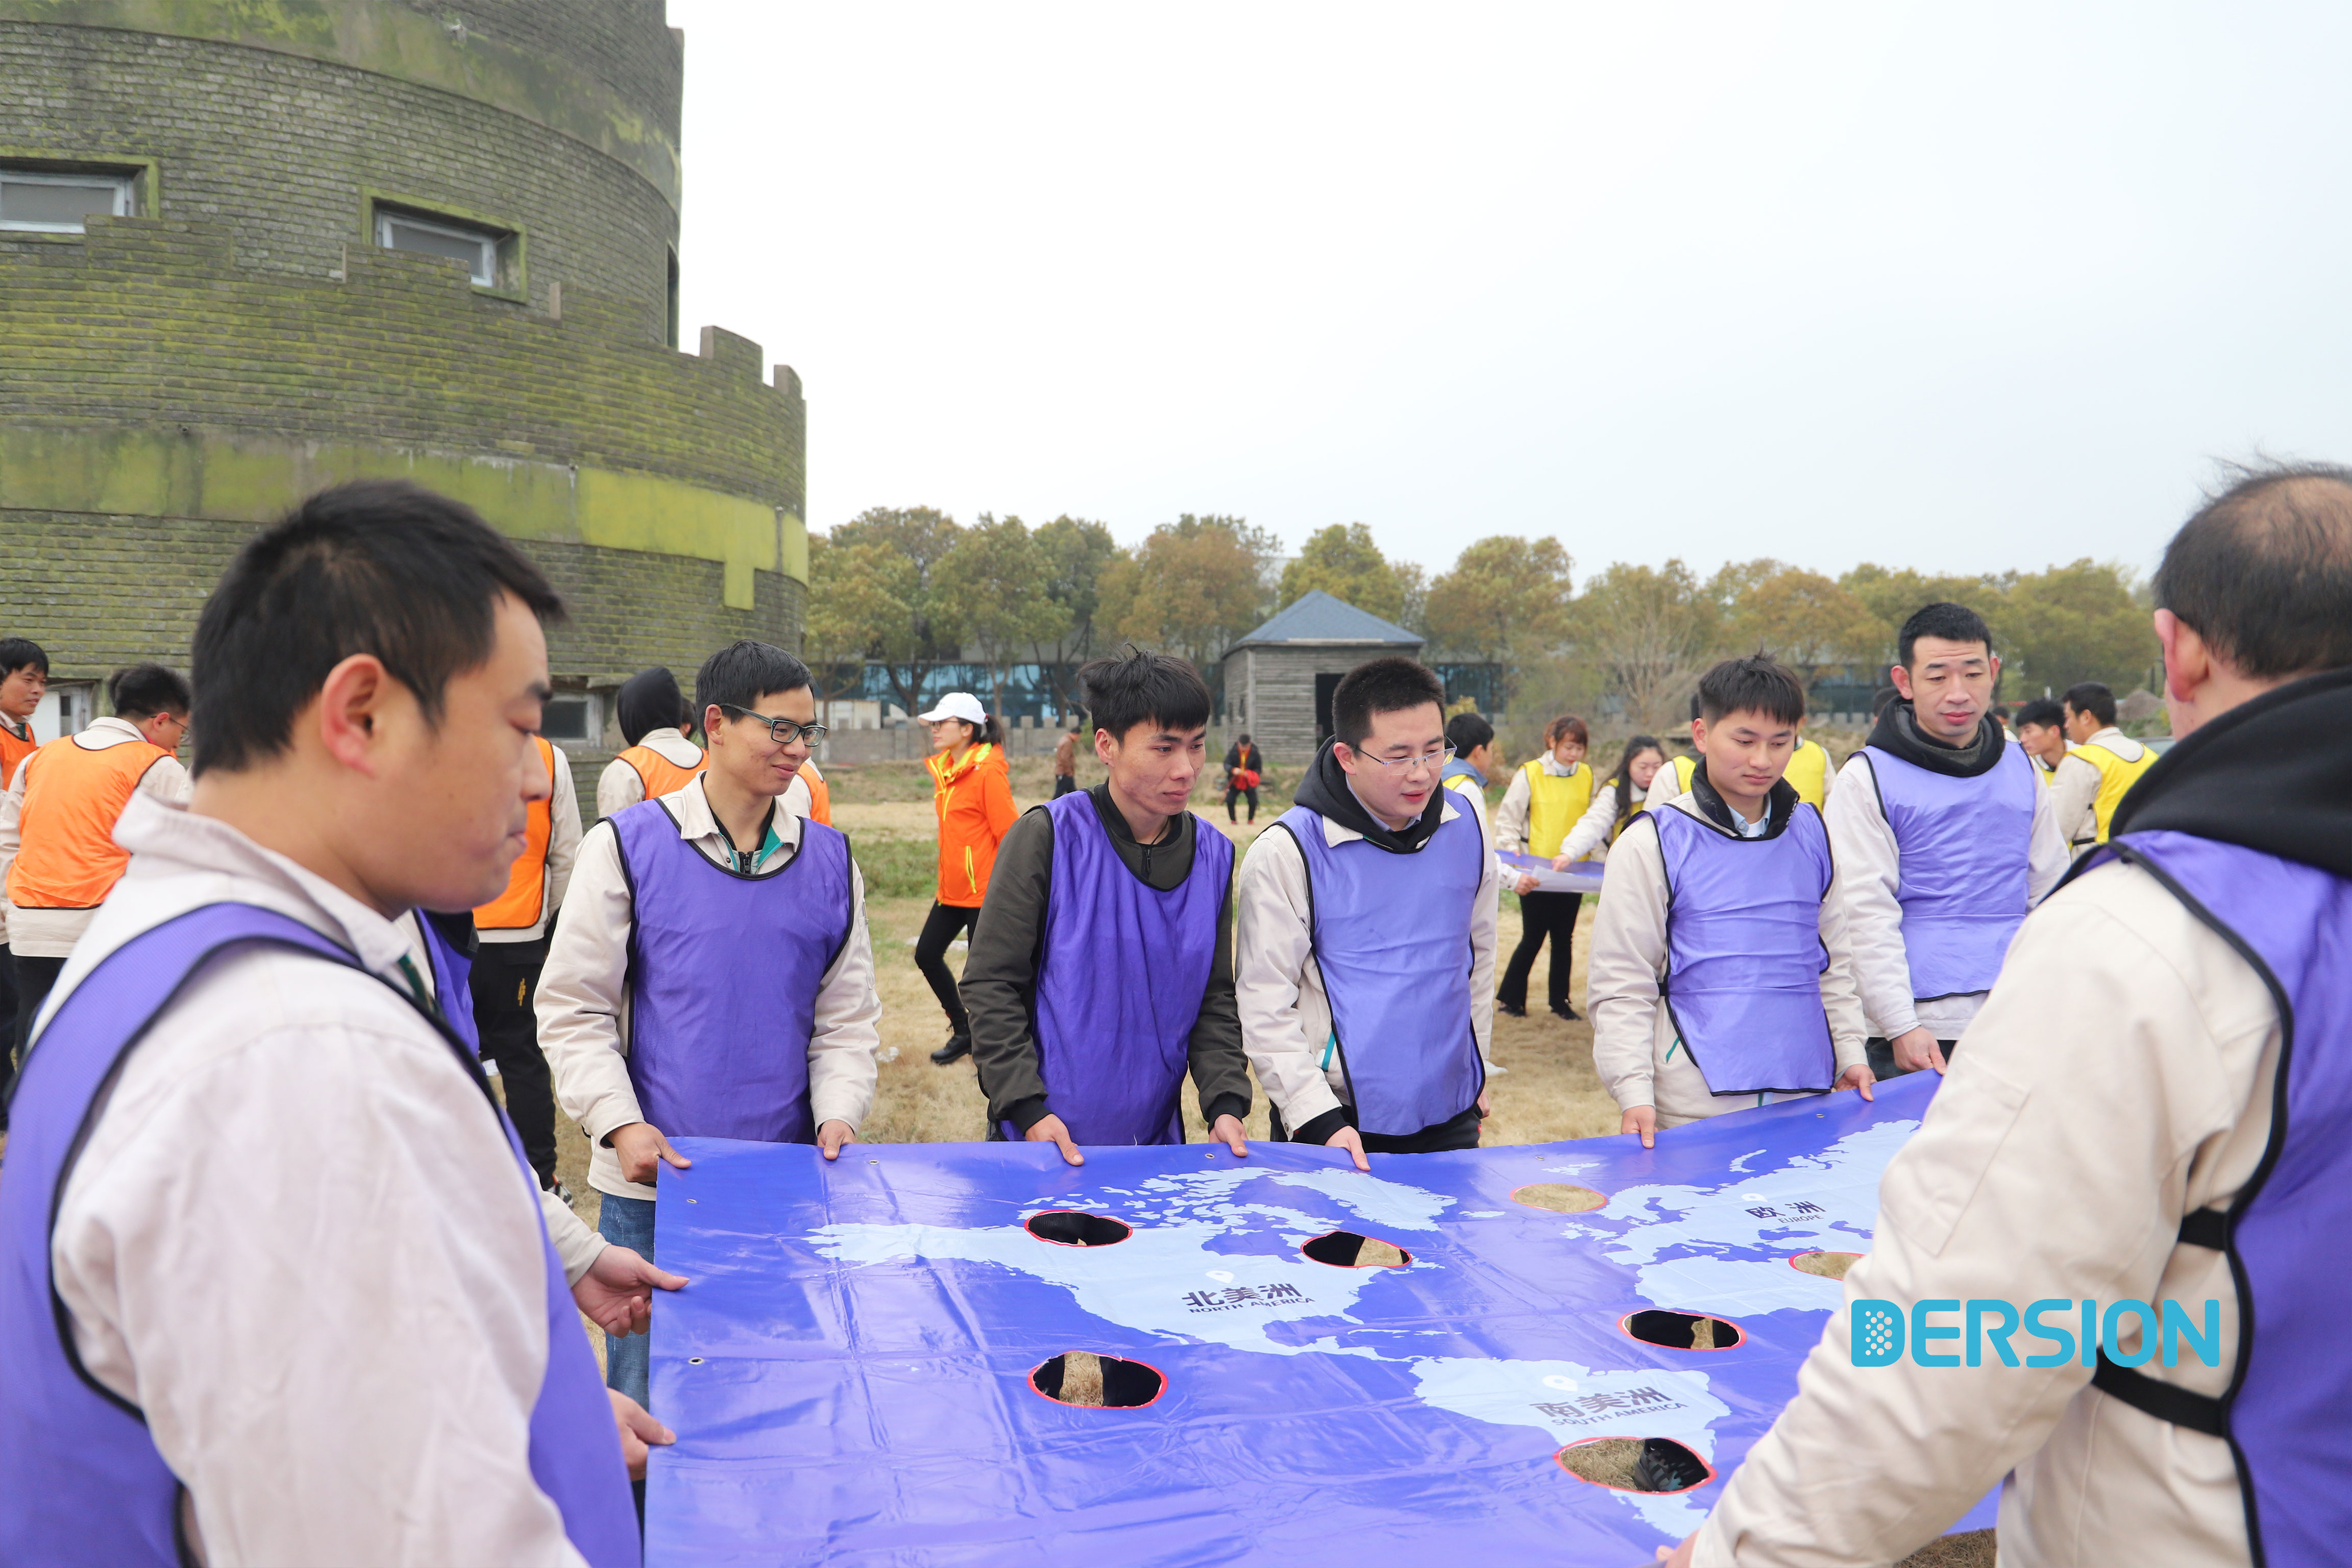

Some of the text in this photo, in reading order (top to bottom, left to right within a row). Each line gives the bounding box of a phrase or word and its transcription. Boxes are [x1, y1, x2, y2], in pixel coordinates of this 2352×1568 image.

[1745, 1201, 1826, 1218] 欧洲
[1778, 1214, 1824, 1223] EUROPE
[1182, 1283, 1303, 1306] 北美洲
[1189, 1297, 1316, 1313] NORTH AMERICA
[1529, 1386, 1674, 1417] 南美洲
[1551, 1403, 1689, 1426] SOUTH AMERICA
